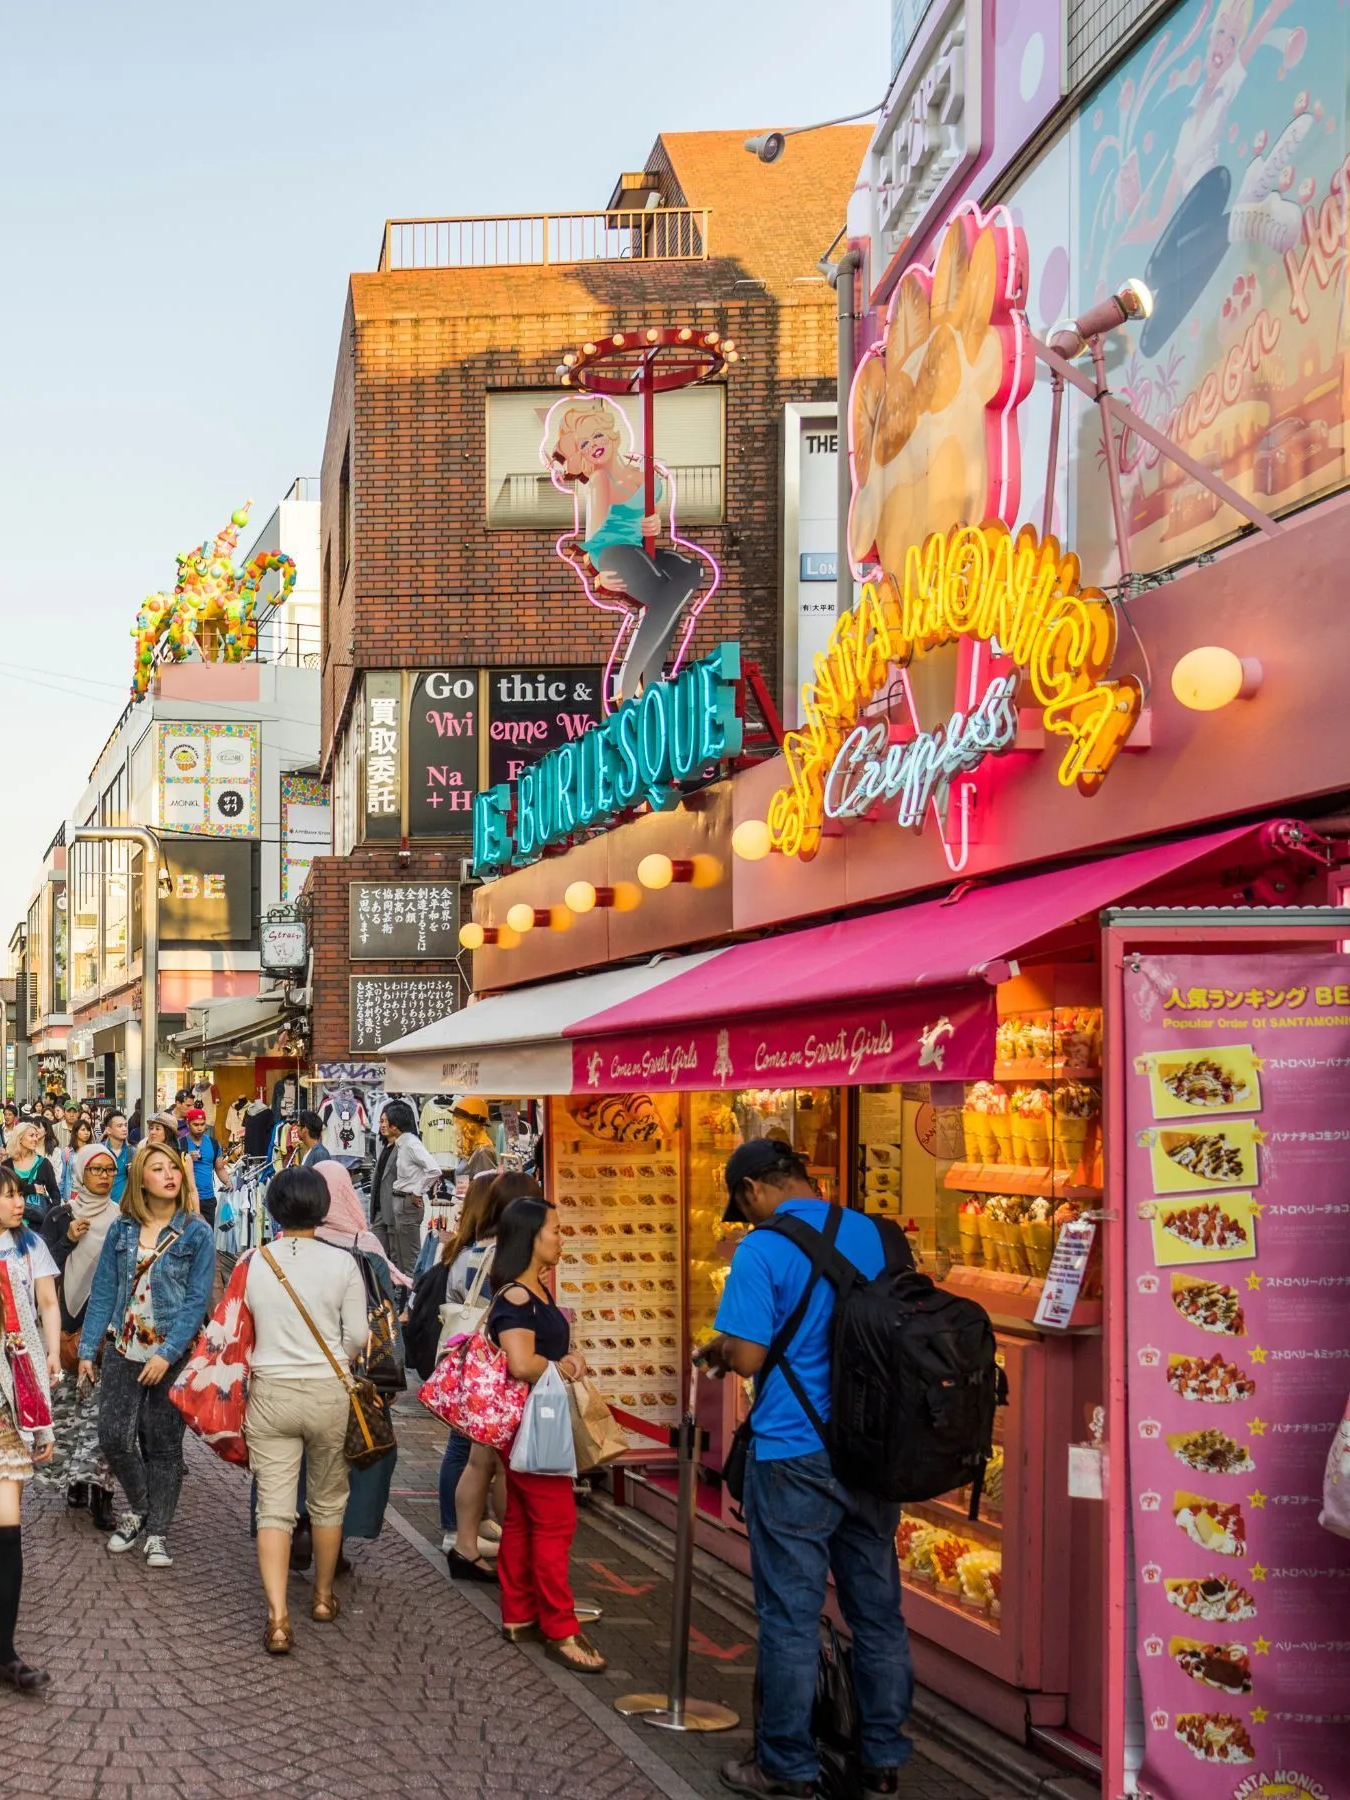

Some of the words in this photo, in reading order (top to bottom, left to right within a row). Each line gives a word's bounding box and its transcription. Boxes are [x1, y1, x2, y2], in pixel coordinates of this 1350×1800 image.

[806, 435, 838, 454] THE
[425, 672, 475, 700] Go
[497, 674, 567, 702] thic
[573, 683, 593, 700] &
[767, 580, 900, 860] SANTA
[902, 523, 1134, 794] MONICA
[426, 711, 474, 738] Vivi
[490, 719, 548, 745] enne
[367, 698, 398, 813] 買取委託
[514, 643, 744, 864] BURLESQUE
[427, 766, 464, 787] Na
[359, 888, 370, 944] と思います
[371, 888, 382, 924] である
[394, 888, 405, 923] 最高の
[405, 887, 417, 924] 全人類
[417, 888, 429, 951] 創造することは
[429, 887, 440, 932] 大平和を
[440, 887, 453, 931] 全世界の
[364, 981, 374, 1033] 大平和創造の
[374, 981, 382, 1044] いのりあうことは
[383, 981, 391, 1026] しあわせを
[391, 981, 400, 1020] わけあう
[400, 981, 409, 1035] はげましあう
[409, 981, 418, 1028] たすけあう
[418, 981, 427, 1027] わかりあう
[1162, 985, 1309, 1011] 人気ランキング
[1162, 1017, 1214, 1029] Popular
[1217, 1018, 1248, 1029] Order
[1252, 1016, 1266, 1028] Of
[610, 1055, 632, 1078] Come
[670, 1040, 698, 1085] Girls
[754, 1042, 788, 1071] Come
[788, 1052, 803, 1066] on
[804, 1027, 849, 1068] Sweet
[848, 1020, 894, 1076] Girls
[1154, 1715, 1165, 1727] 10
